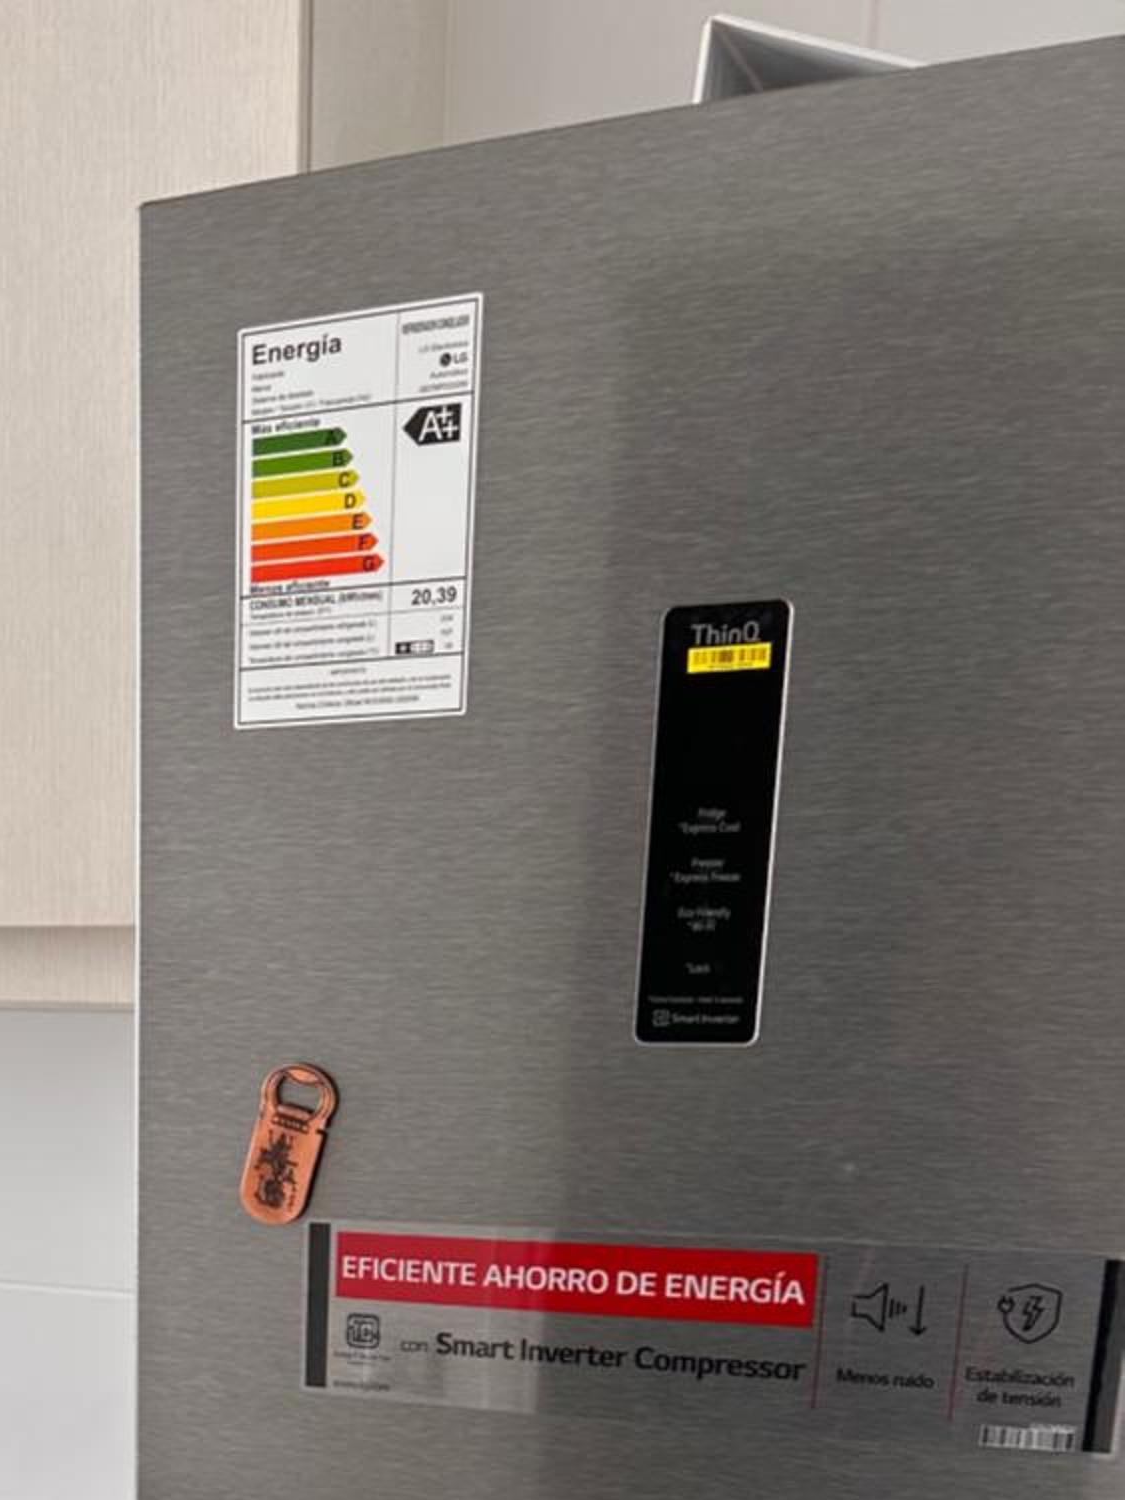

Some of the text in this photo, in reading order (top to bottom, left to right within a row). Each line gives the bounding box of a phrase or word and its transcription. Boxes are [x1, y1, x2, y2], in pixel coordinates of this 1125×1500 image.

[251, 333, 342, 365] Energía
[332, 450, 345, 467] B
[338, 471, 351, 488] C
[344, 493, 357, 510] D
[352, 513, 364, 530] E
[358, 534, 372, 551] F
[363, 555, 377, 572] G
[411, 586, 457, 607] 20,39
[690, 620, 762, 645] ThinQ
[342, 1255, 805, 1305] EFICIENTE AHORRO DE ENERGÍA
[400, 1331, 807, 1381] con Smart Inverter Compressor
[836, 1368, 935, 1389] Menos ruido
[977, 1388, 998, 1404] de
